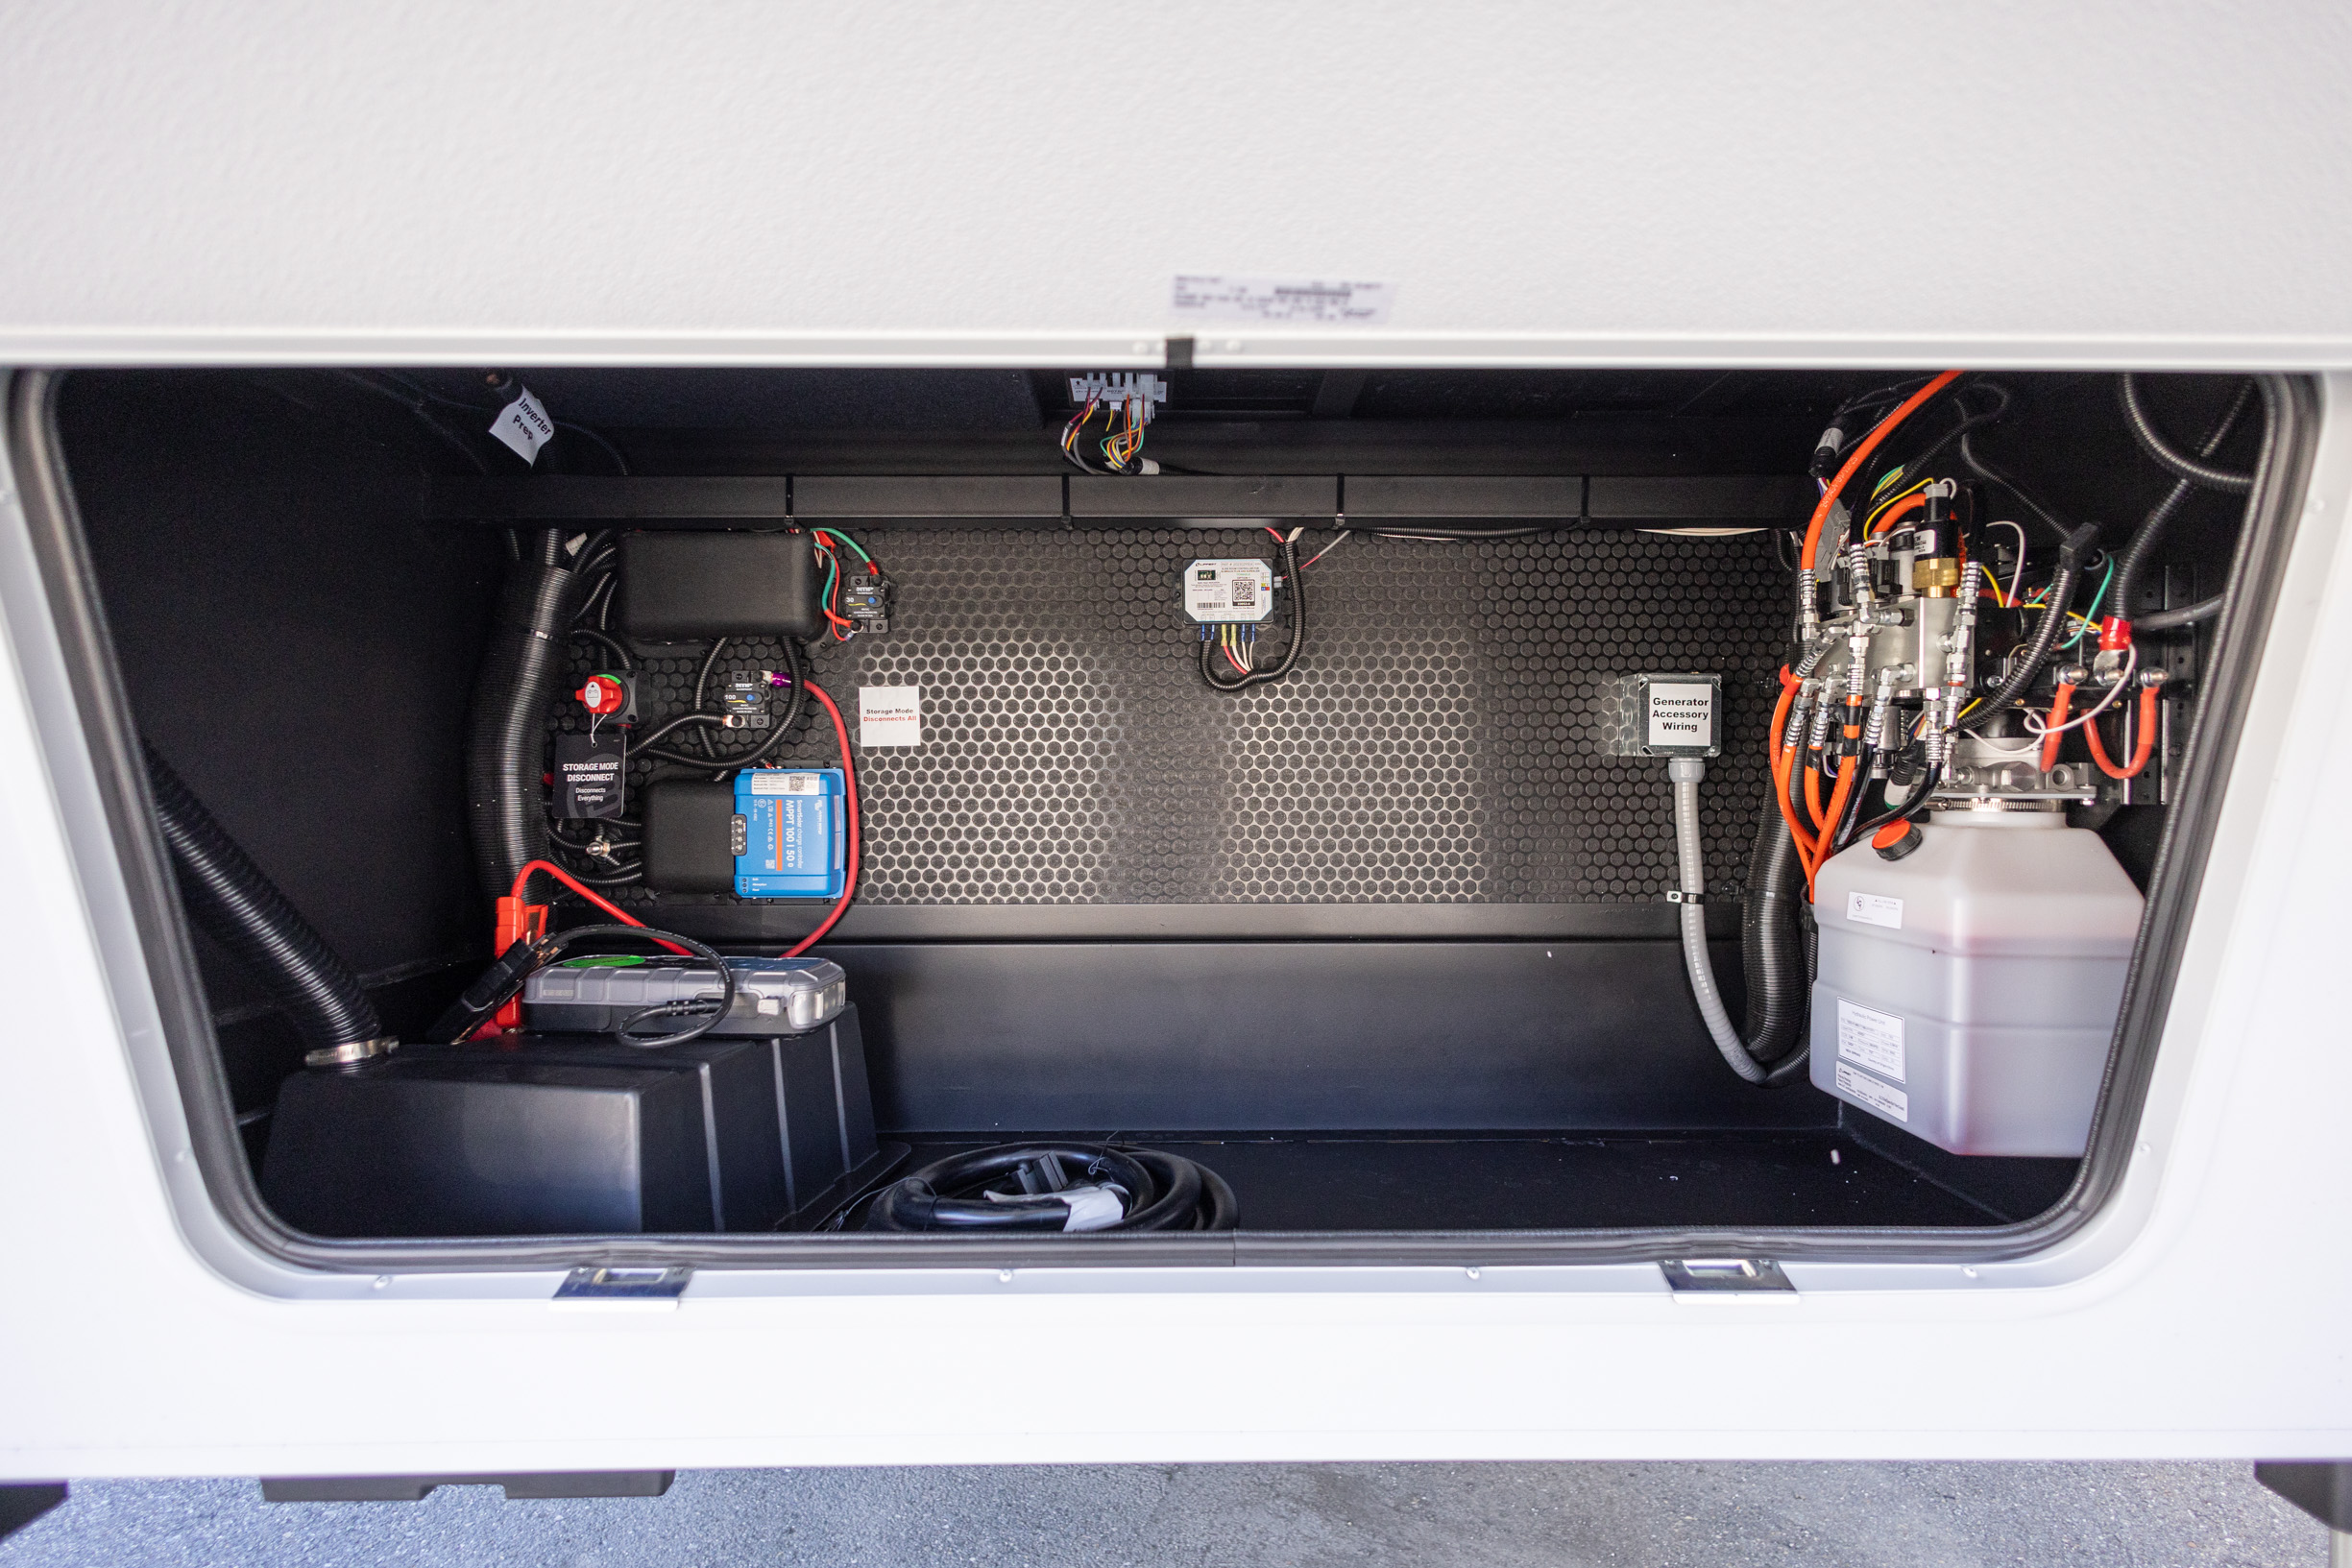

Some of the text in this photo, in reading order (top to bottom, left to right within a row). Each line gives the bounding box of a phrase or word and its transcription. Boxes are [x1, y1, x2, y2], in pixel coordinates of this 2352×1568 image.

[519, 398, 551, 435] Inverter
[512, 414, 533, 440] Prep
[1653, 697, 1709, 706] Generator
[1652, 710, 1709, 720] Accessory
[1662, 723, 1698, 732] Wiring
[563, 762, 619, 771] STORAGE MODE
[567, 773, 614, 782] DISCONNECT
[785, 800, 795, 825] MPPT
[786, 827, 795, 841] 100
[786, 850, 795, 861] 50
